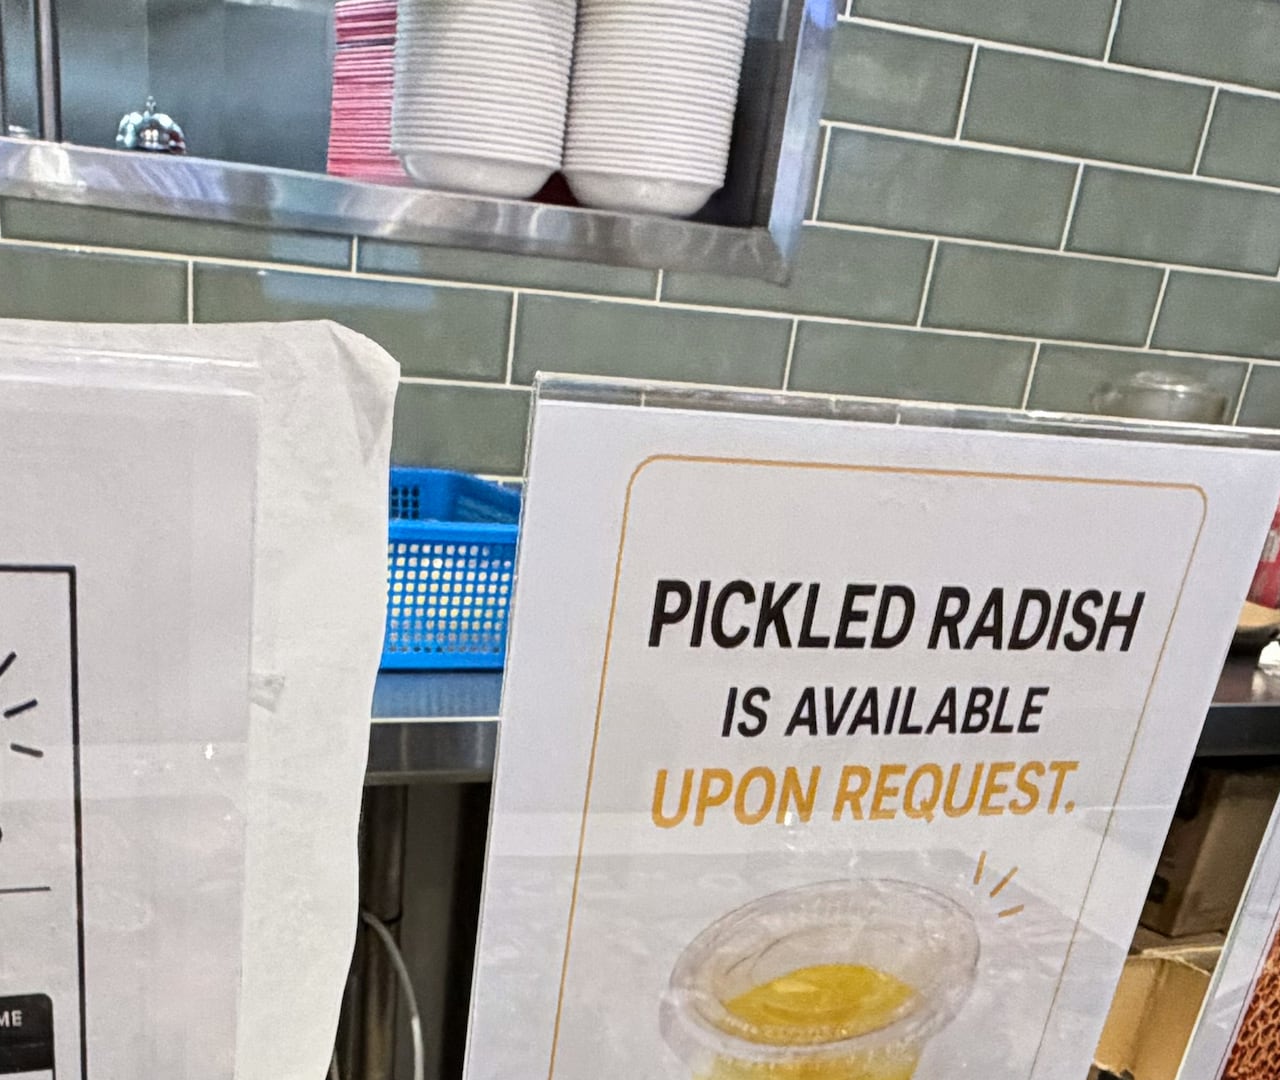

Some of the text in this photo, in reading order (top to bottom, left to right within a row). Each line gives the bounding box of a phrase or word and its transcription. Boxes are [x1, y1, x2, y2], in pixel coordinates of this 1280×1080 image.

[647, 578, 1147, 653] PICKLED RADISH
[722, 686, 1050, 738] IS AVAILABLE
[651, 760, 1080, 829] UPON REQUEST.
